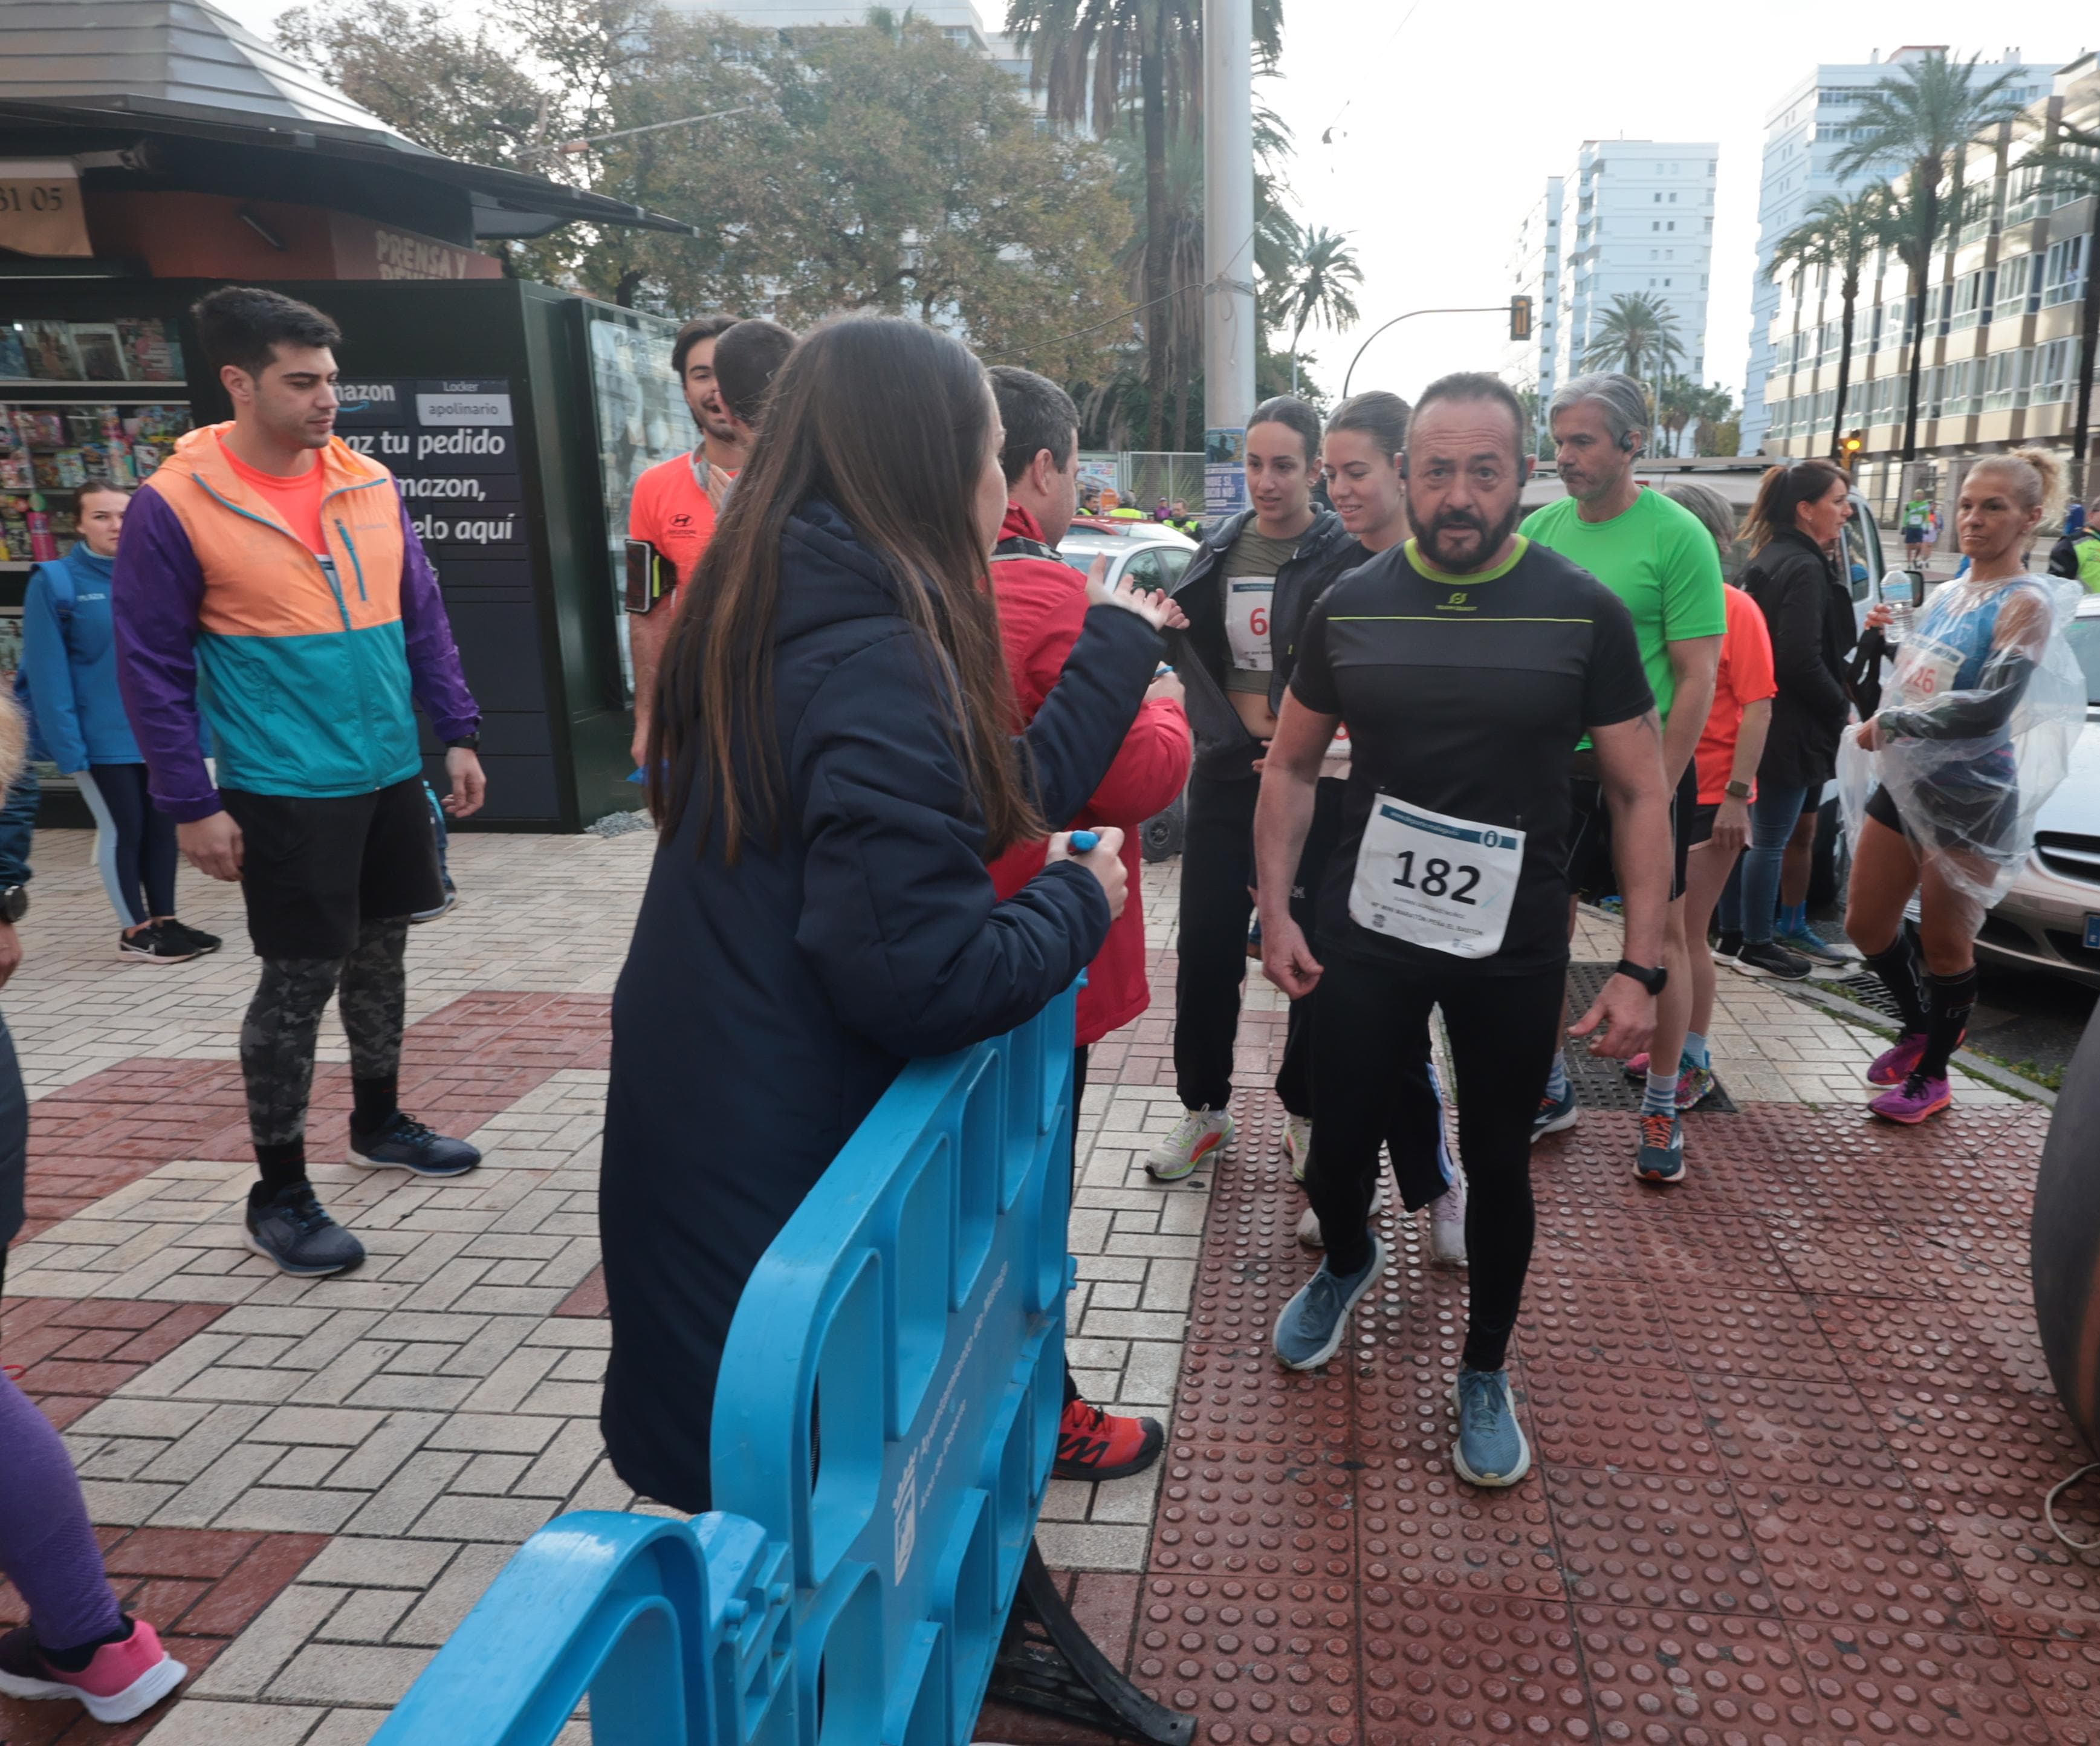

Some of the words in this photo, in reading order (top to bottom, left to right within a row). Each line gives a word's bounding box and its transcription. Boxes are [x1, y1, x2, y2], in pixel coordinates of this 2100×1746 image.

[31, 186, 62, 211] 05
[375, 230, 451, 279] PRENSA
[455, 252, 467, 279] Y
[442, 380, 479, 392] Locker
[428, 403, 499, 417] apolinario
[345, 435, 375, 453] az
[380, 431, 410, 454] tu
[417, 428, 506, 460] pedido
[455, 513, 516, 544] aquí
[1392, 850, 1481, 906] 182
